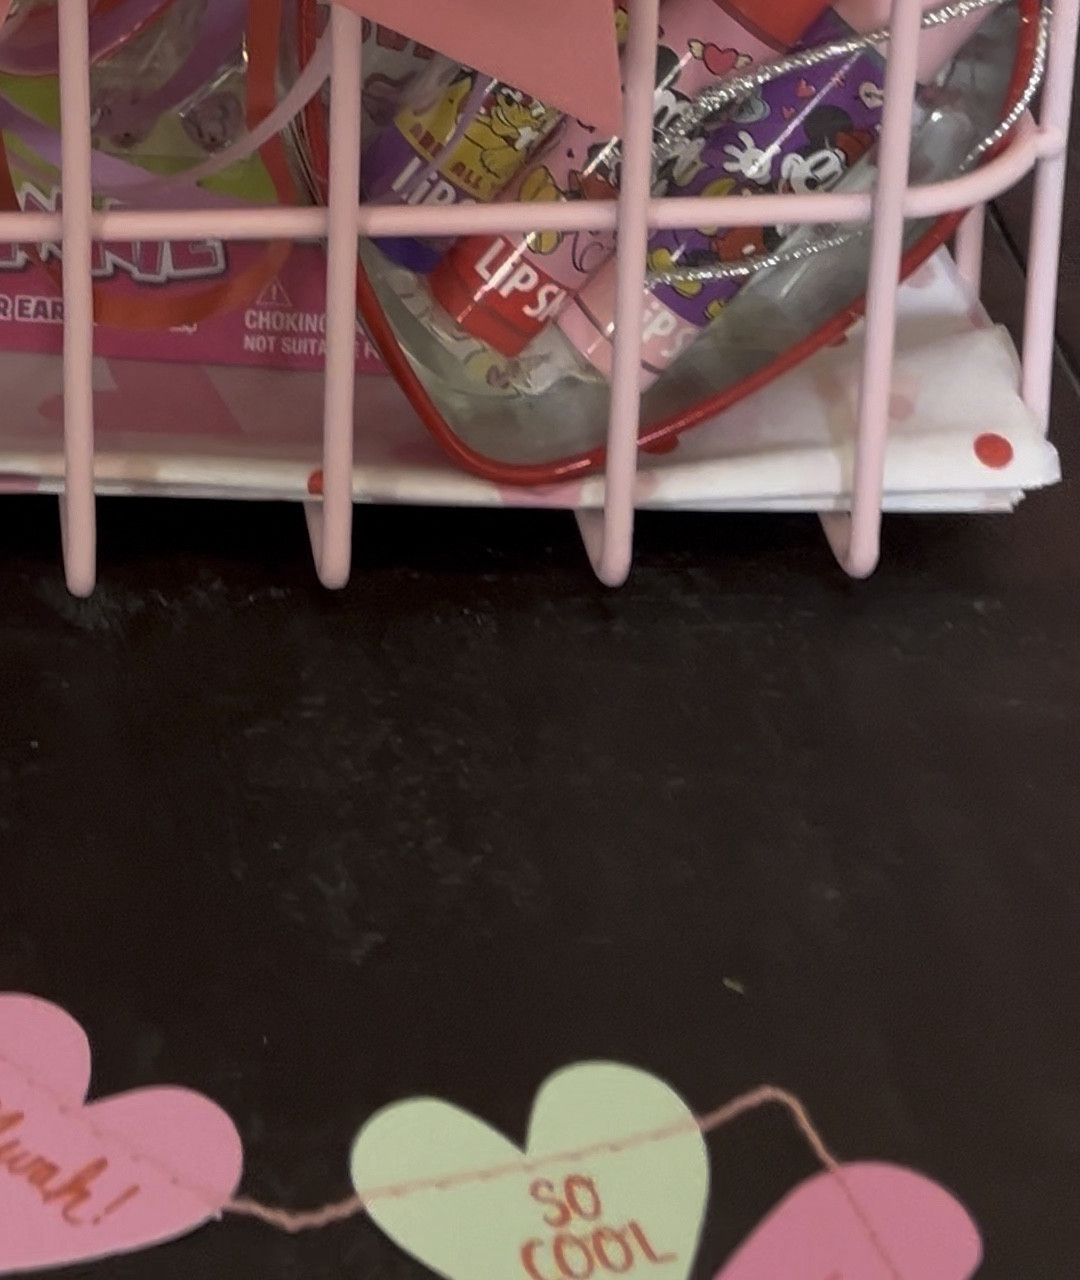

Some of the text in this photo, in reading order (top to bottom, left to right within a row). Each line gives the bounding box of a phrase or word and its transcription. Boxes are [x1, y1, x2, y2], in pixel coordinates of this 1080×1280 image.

[244, 334, 275, 352] NOT
[528, 1174, 602, 1228] SO
[520, 1218, 679, 1279] COOL
